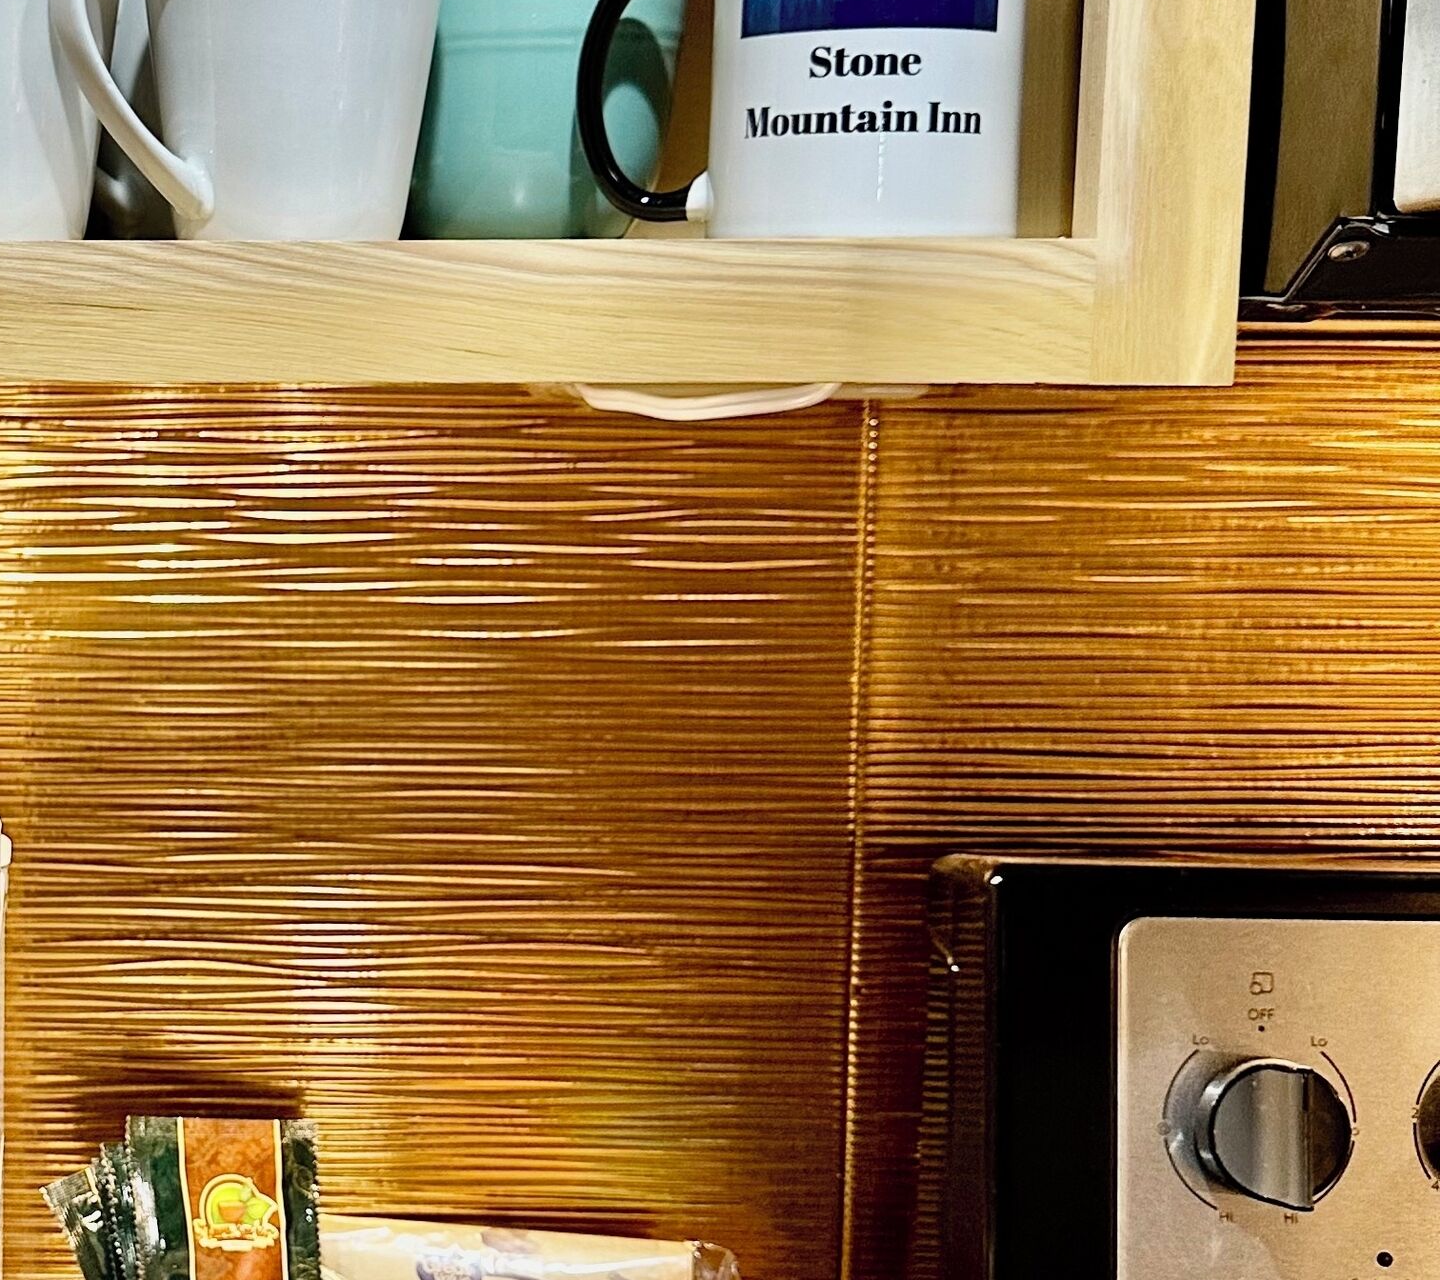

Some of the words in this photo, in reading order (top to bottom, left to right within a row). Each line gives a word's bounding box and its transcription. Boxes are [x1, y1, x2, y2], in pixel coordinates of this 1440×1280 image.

[808, 45, 922, 80] Stone
[744, 100, 920, 140] Mountain
[926, 101, 982, 137] Inn
[1247, 1008, 1274, 1021] OFF
